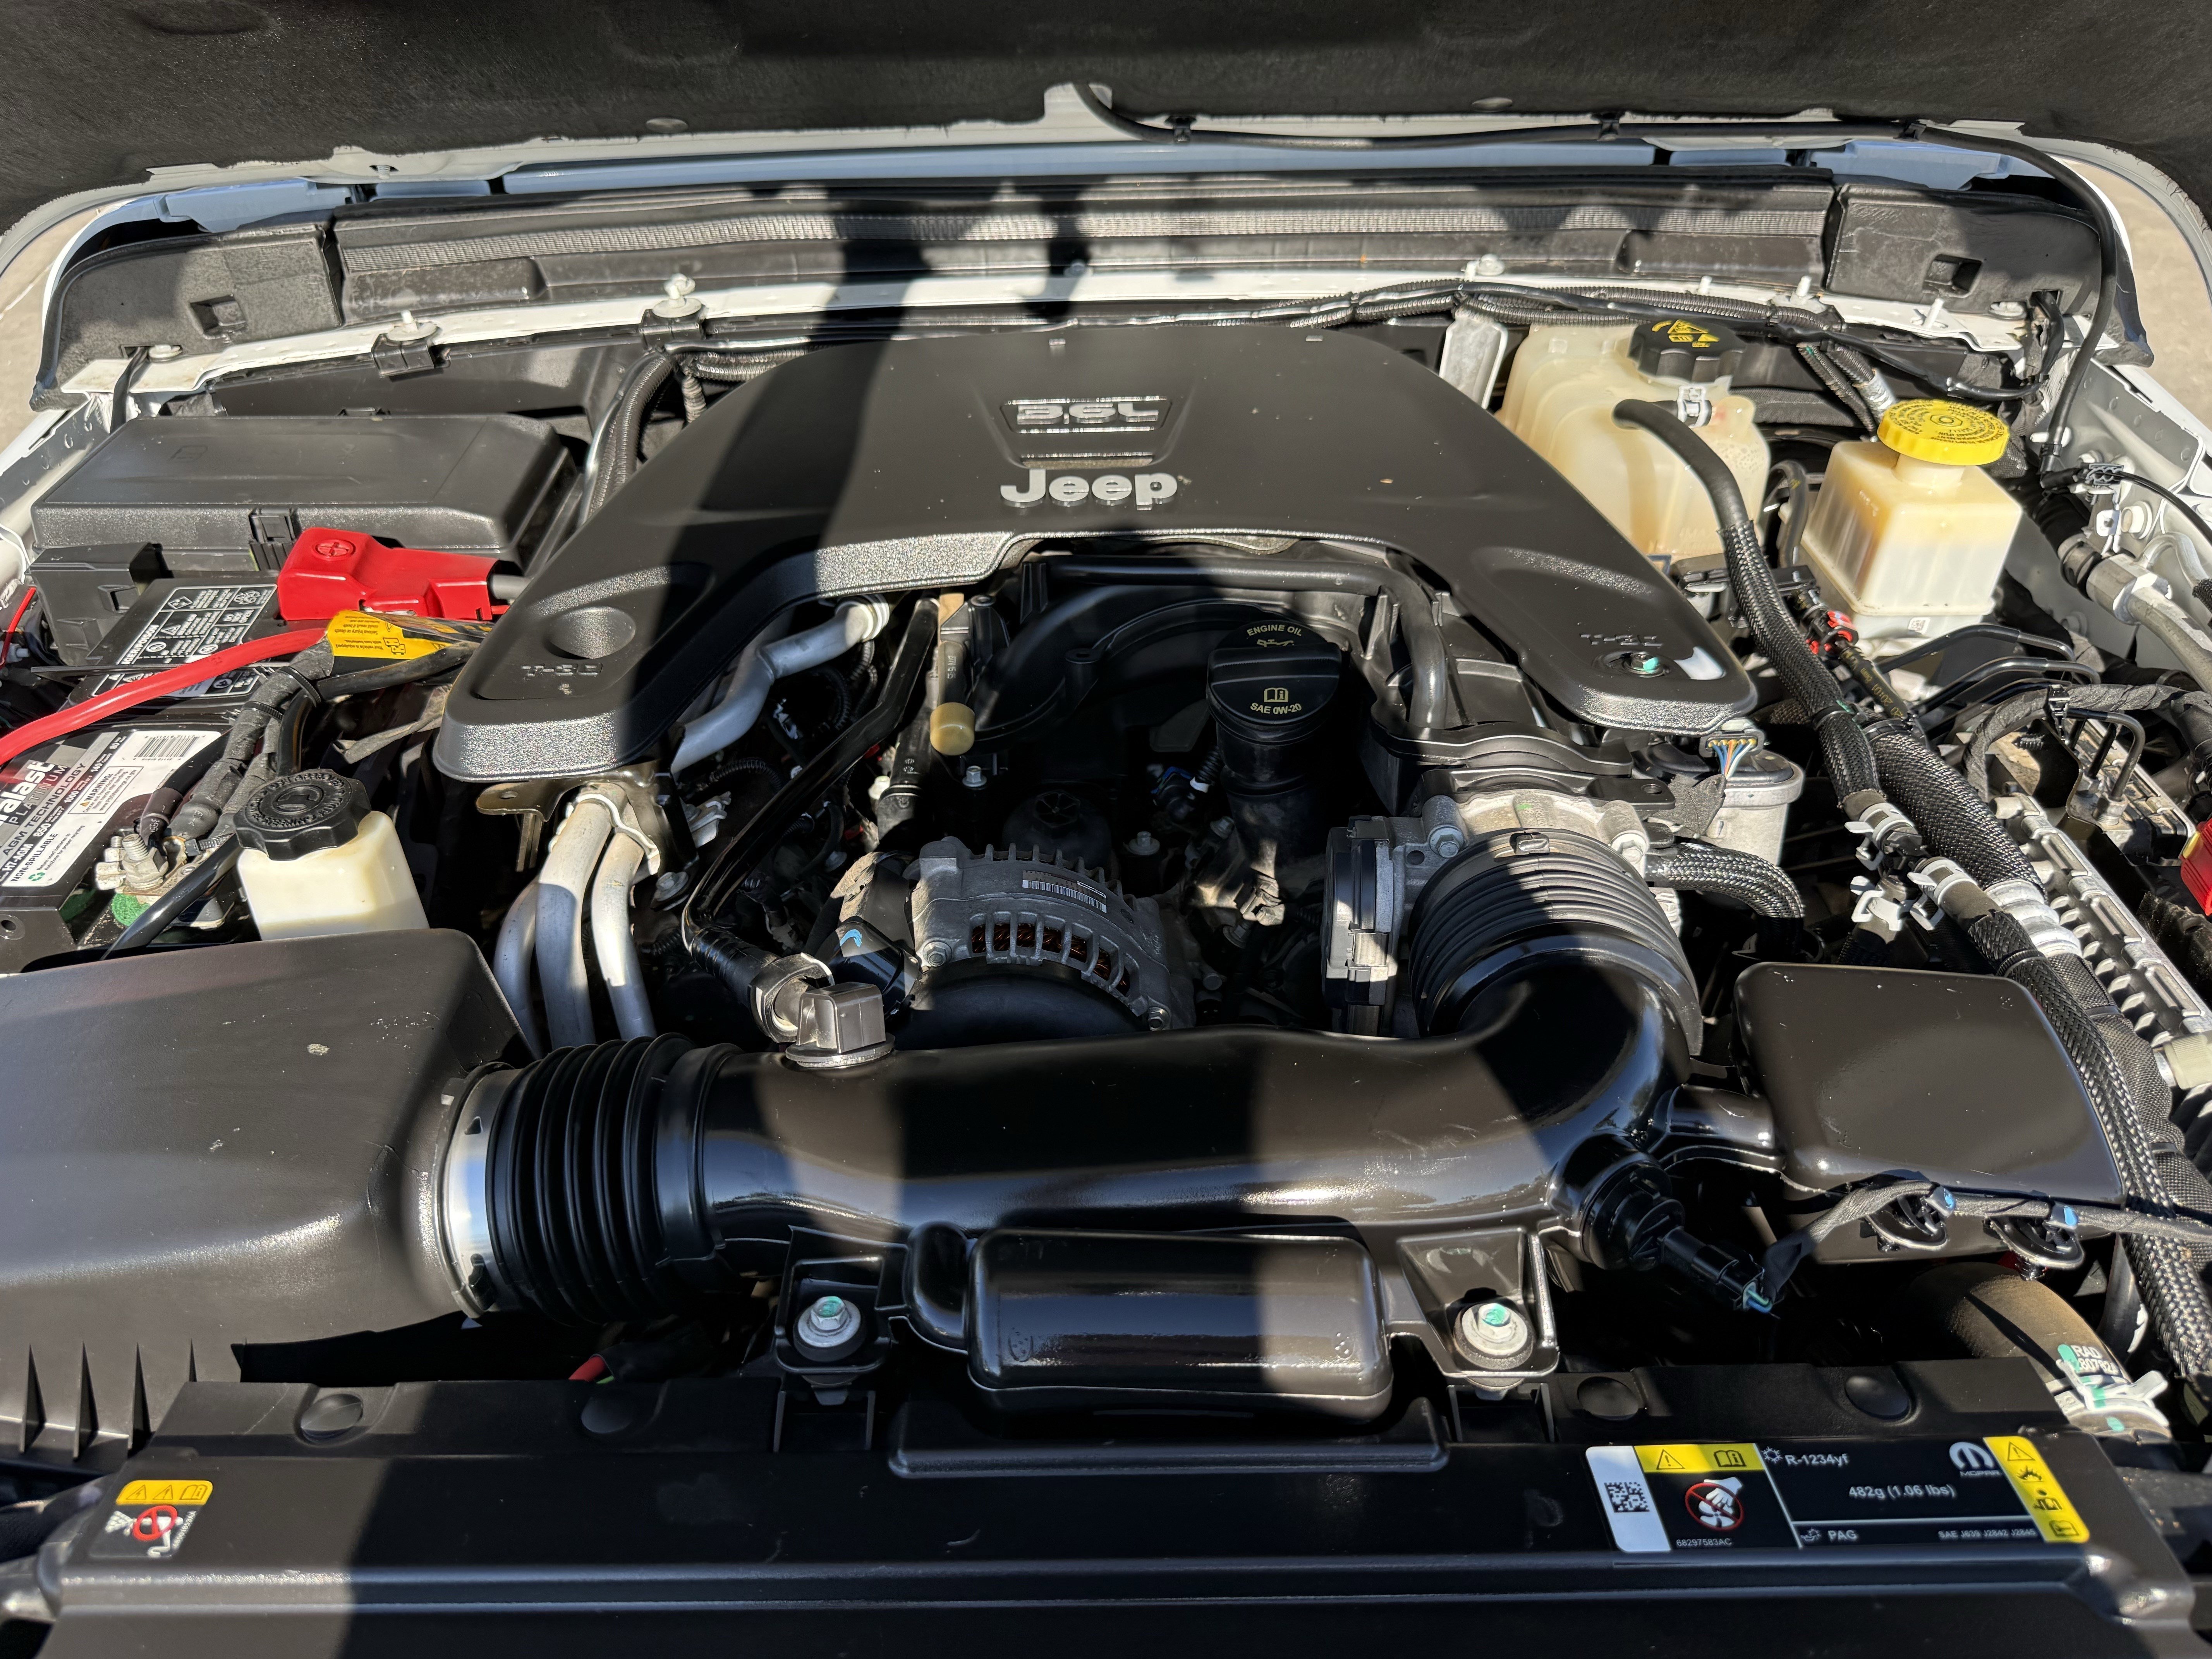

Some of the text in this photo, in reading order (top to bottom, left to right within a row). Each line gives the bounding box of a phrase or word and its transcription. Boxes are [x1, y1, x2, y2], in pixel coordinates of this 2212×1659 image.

[1000, 468, 1178, 510] Jeep
[1247, 624, 1302, 636] ENGINE OIL
[1250, 702, 1302, 714] SAE 0W-20
[9, 765, 68, 824] PLATINUM
[84, 773, 113, 801] WARNING:
[2, 844, 34, 871] H7-AGM
[33, 823, 51, 837] 850
[64, 791, 79, 803] 1000
[91, 763, 103, 773] 140
[3, 831, 27, 856] AGM
[24, 763, 86, 828] TECHNOLOGY
[10, 833, 58, 882] NON-SPILLABLE
[2070, 1345, 2103, 1359] RAD
[1785, 1453, 1850, 1467] R-1234yf
[1849, 1484, 1956, 1500] 482g (1.06 lbs)
[1676, 1538, 1732, 1546] 68297583AC
[1828, 1530, 1857, 1541] PAG
